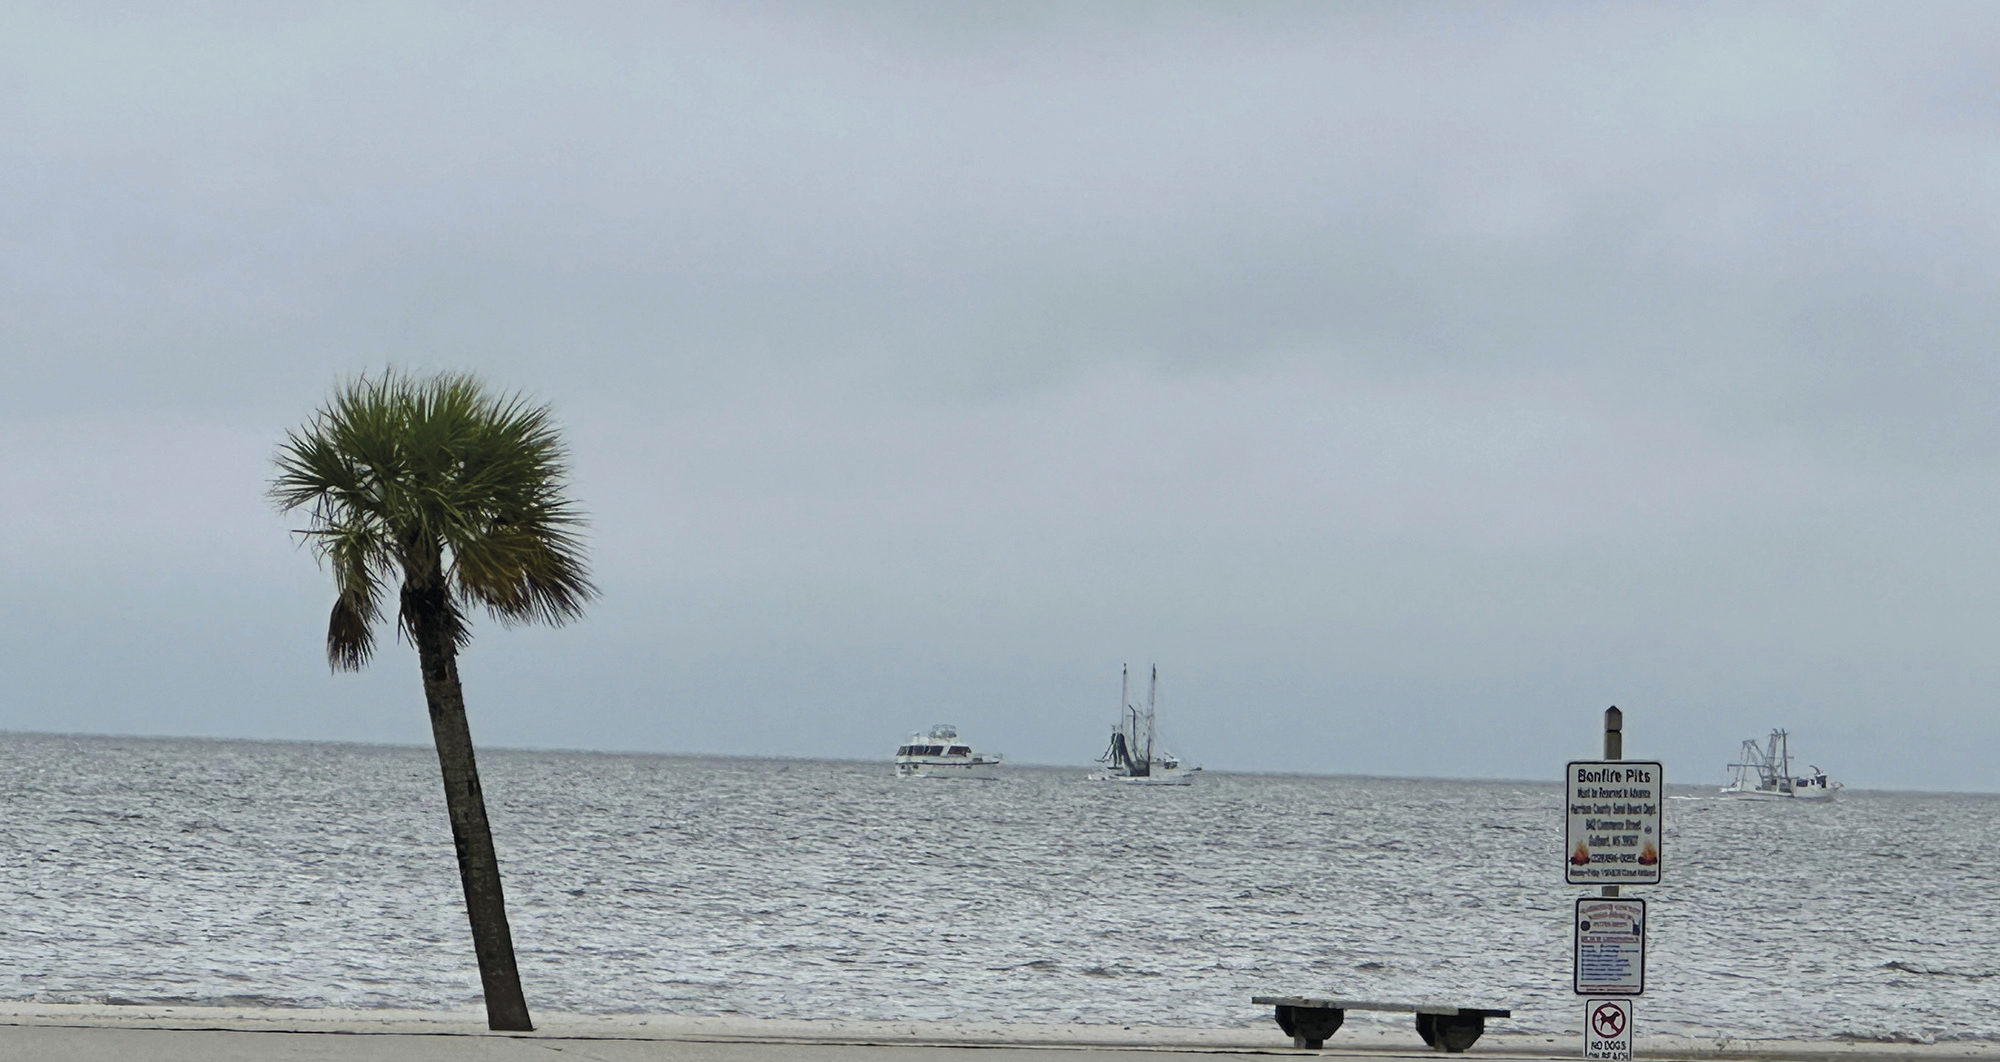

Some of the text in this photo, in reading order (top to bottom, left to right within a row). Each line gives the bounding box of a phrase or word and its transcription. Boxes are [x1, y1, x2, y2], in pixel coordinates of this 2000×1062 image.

[1578, 768, 1651, 783] Bonfire Pits
[1591, 1041, 1626, 1050] NO DOGS
